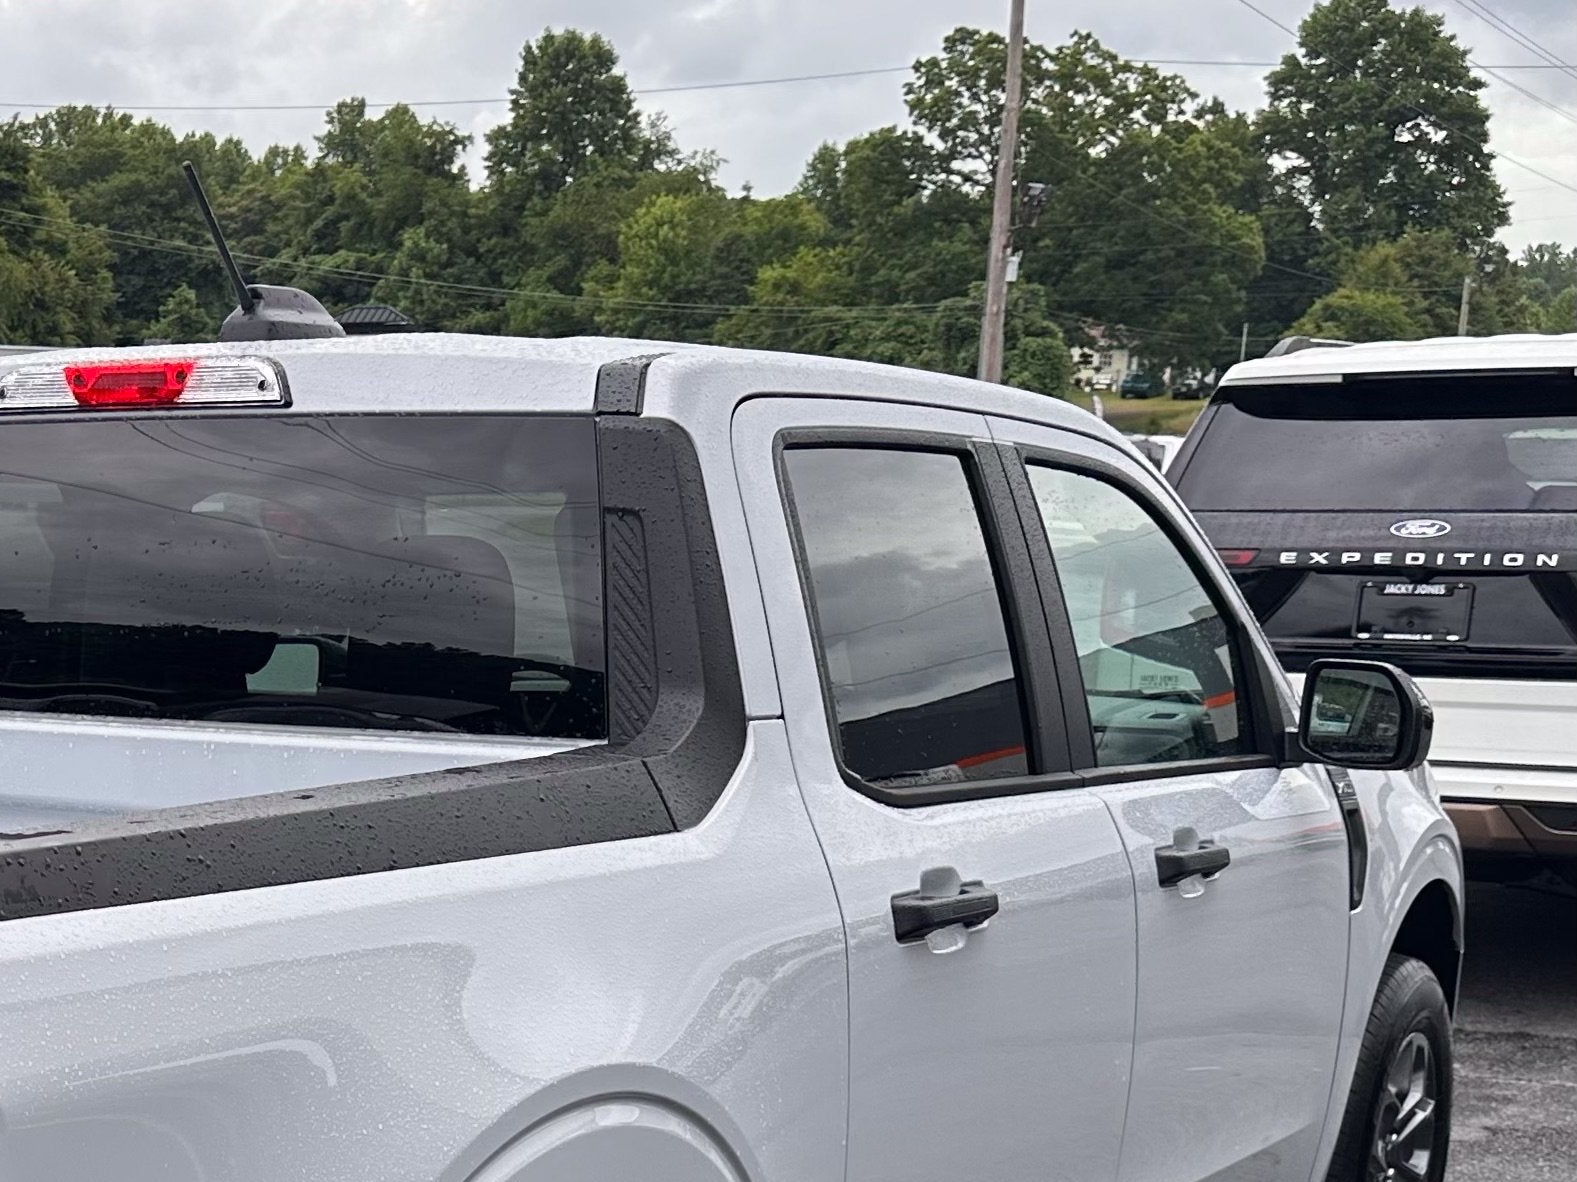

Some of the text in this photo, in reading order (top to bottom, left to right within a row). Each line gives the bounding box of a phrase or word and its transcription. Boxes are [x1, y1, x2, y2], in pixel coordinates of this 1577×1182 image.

[1279, 552, 1560, 567] EXPEDITION
[1383, 583, 1445, 594] JACKY JONES
